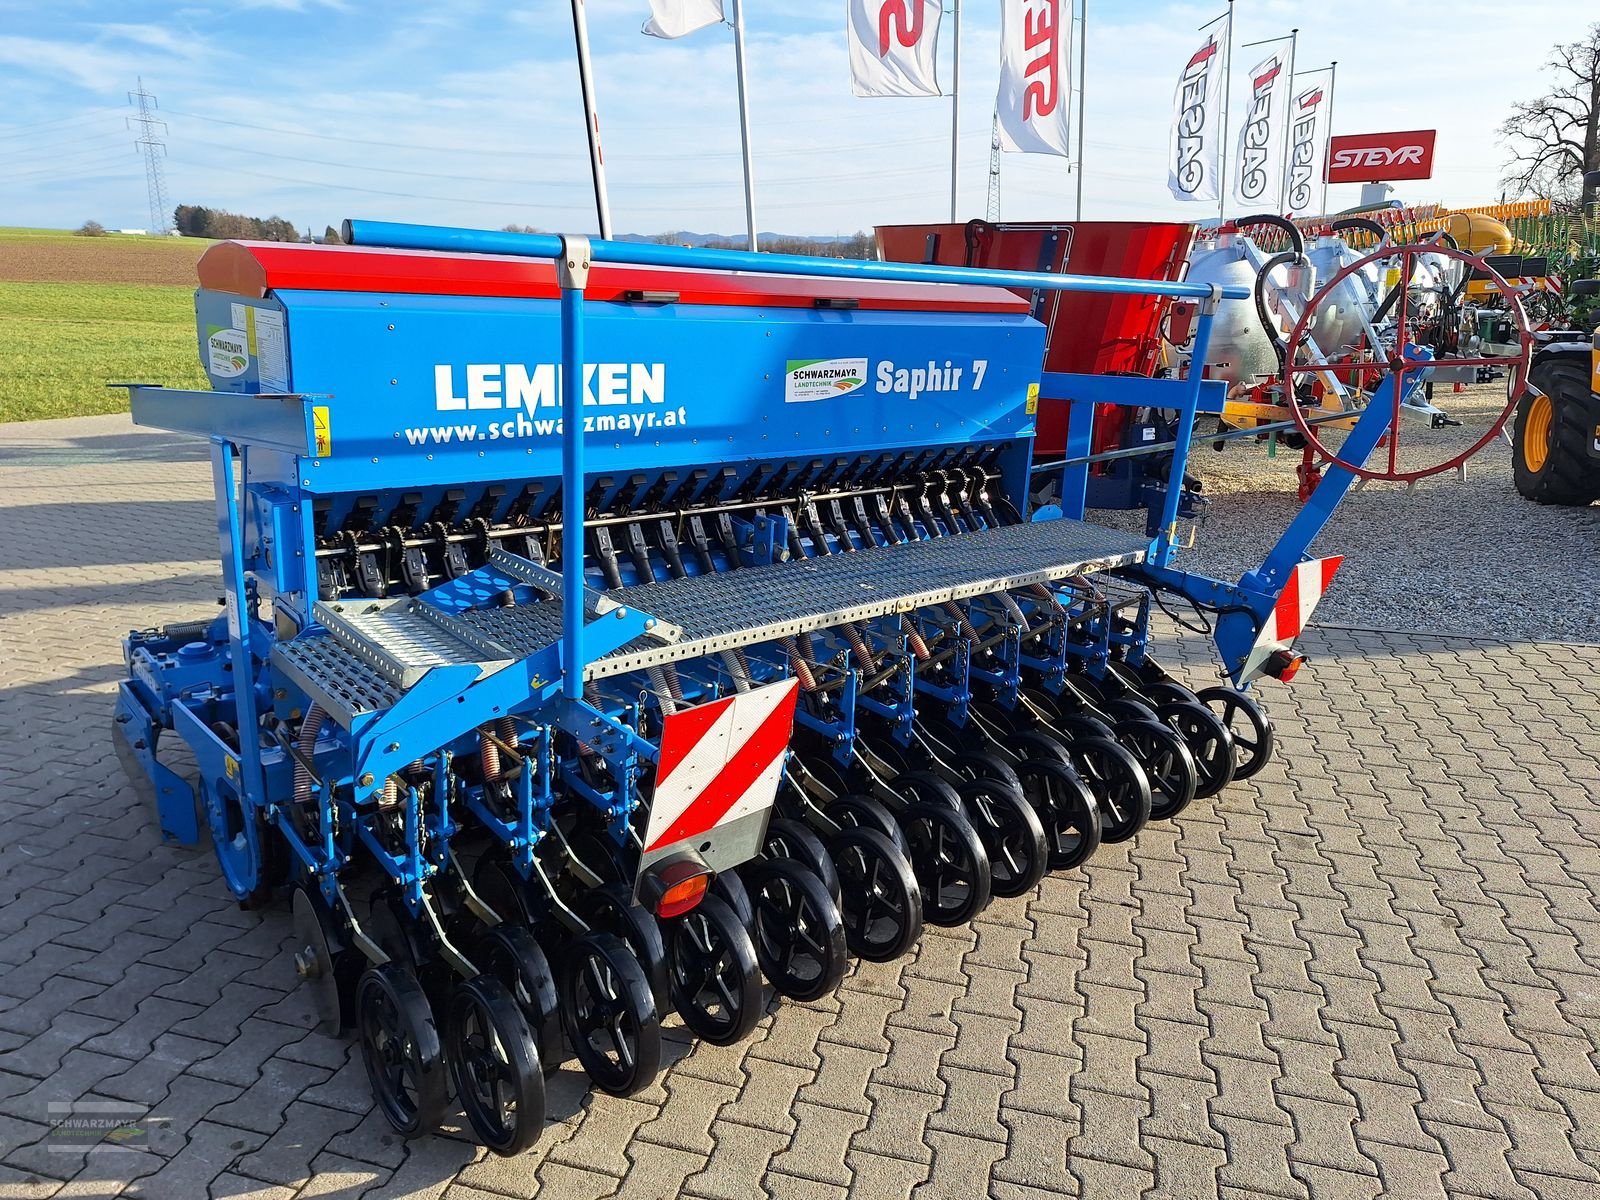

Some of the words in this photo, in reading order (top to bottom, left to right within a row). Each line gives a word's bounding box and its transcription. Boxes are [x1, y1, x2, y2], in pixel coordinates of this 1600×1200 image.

[1331, 145, 1424, 168] STEYR
[793, 368, 857, 380] SCHWARZMAYR
[875, 360, 963, 400] Saphir
[972, 360, 987, 390] 7
[405, 406, 686, 445] www.schwazmayr.at
